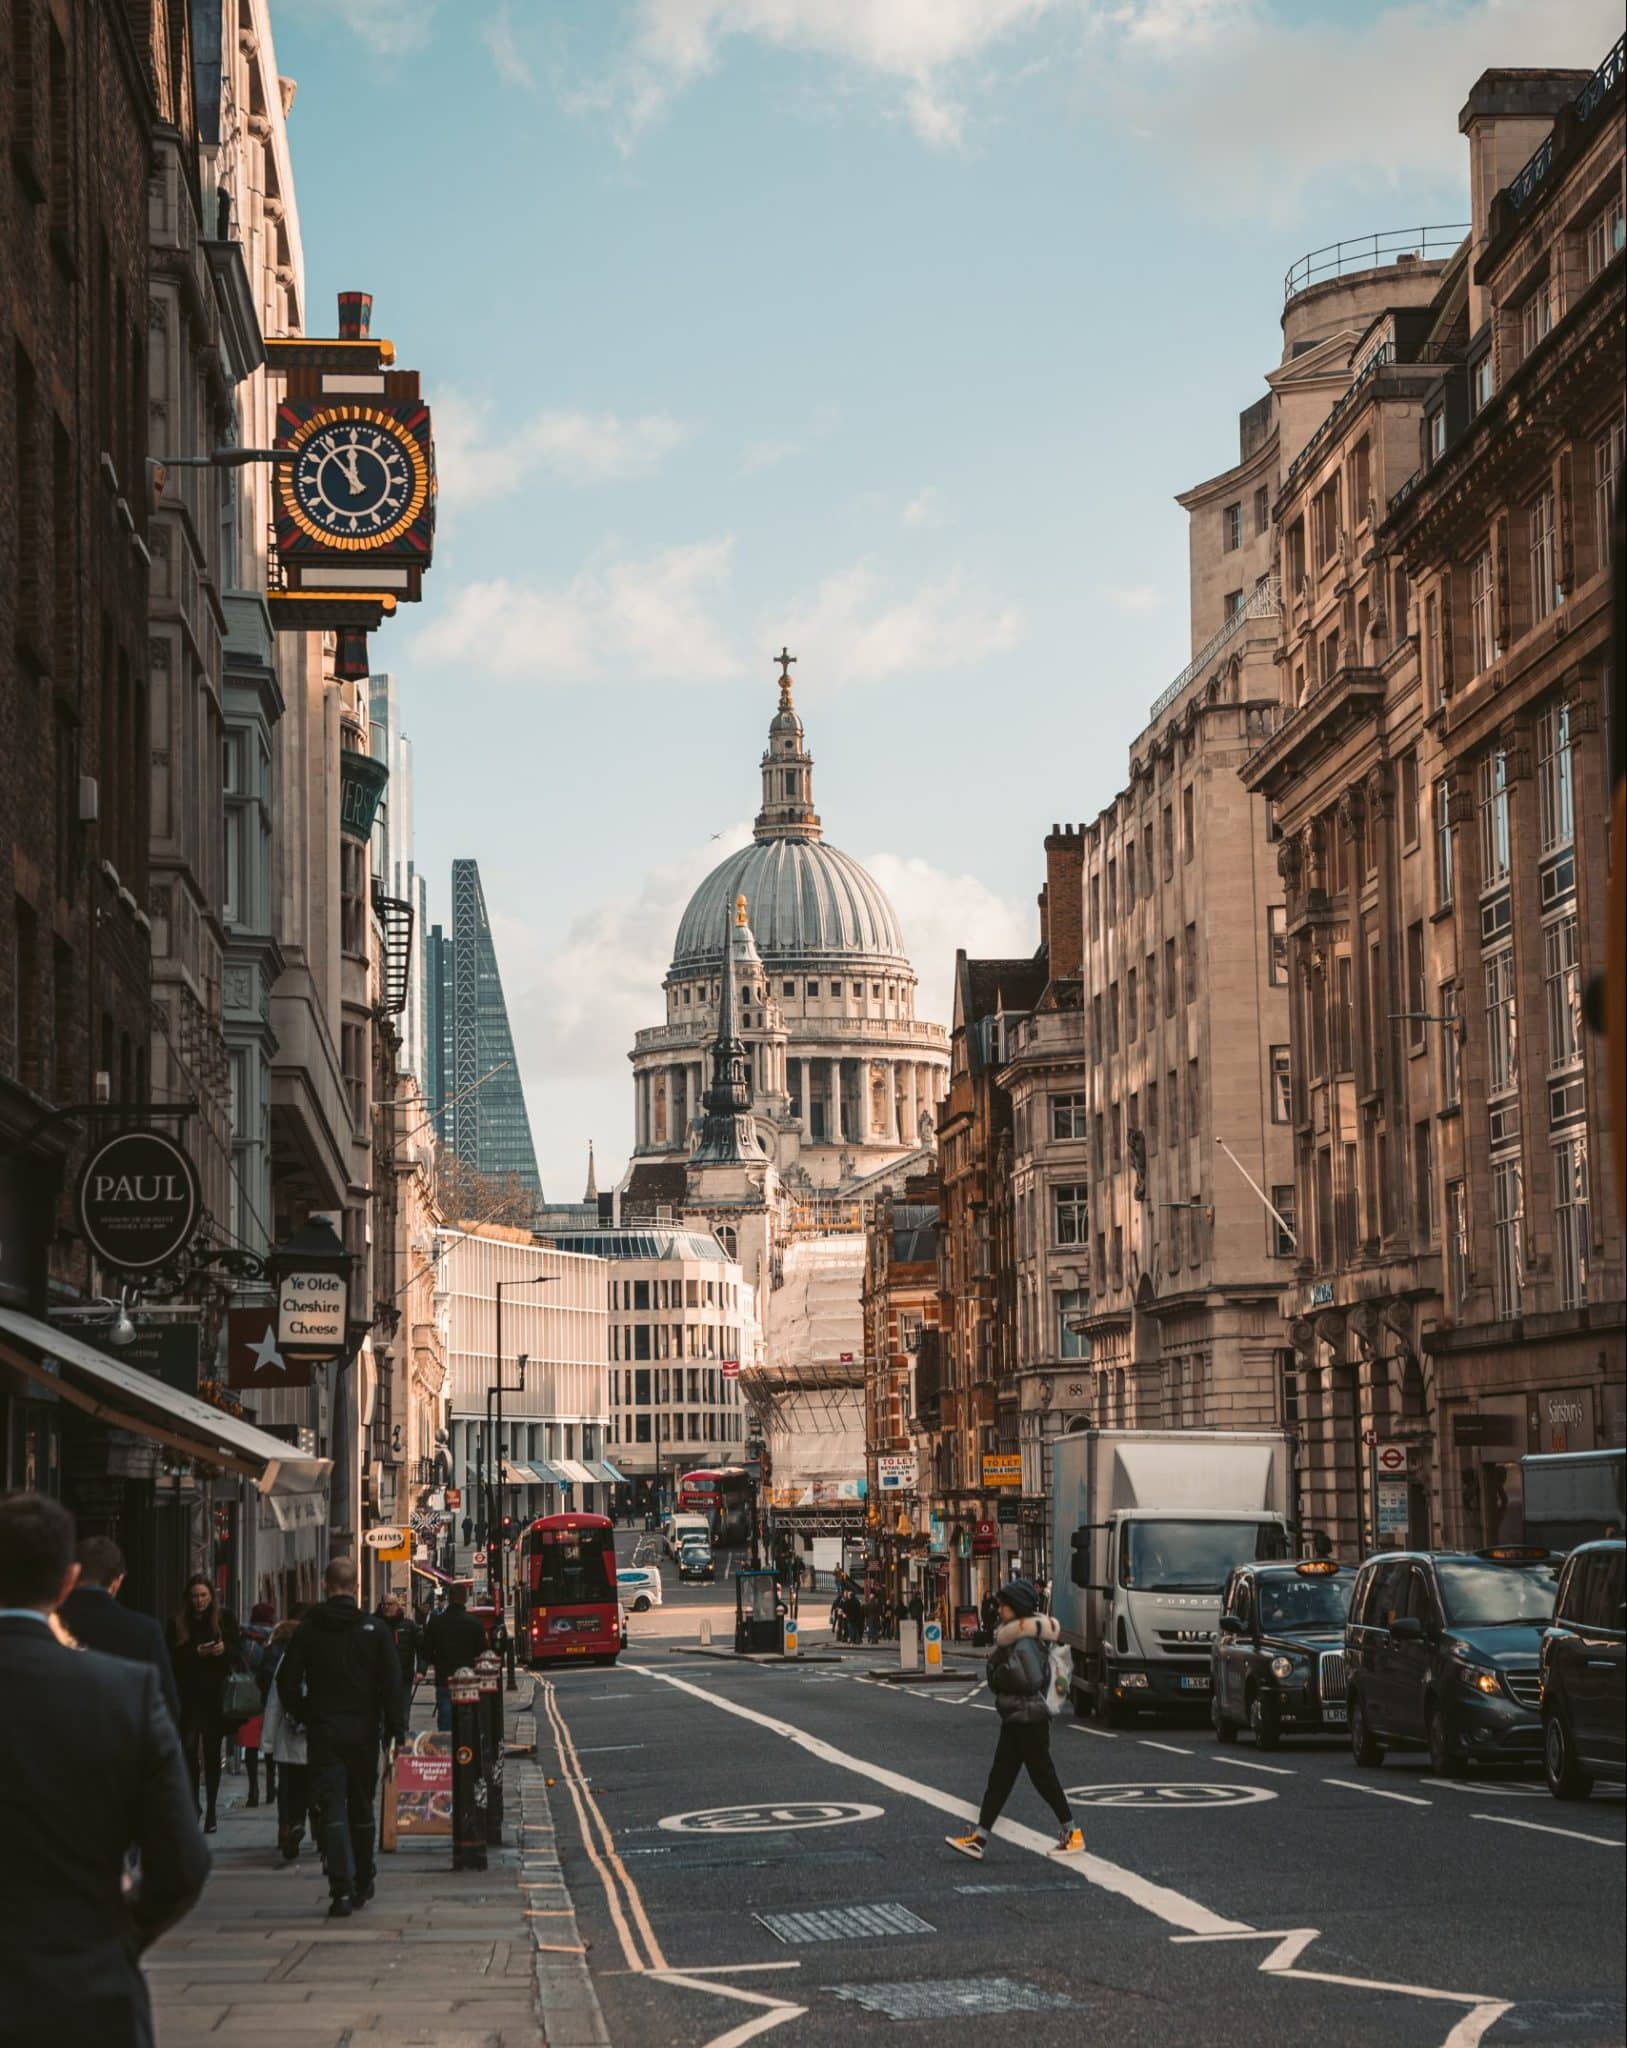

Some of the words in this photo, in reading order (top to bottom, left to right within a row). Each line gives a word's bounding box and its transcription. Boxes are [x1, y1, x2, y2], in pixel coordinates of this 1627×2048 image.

[94, 1175, 185, 1201] PAUL
[291, 1277, 305, 1290] Ye
[307, 1278, 339, 1291] Olde
[283, 1299, 340, 1312] Cheshire
[289, 1321, 338, 1335] Cheese
[1068, 1383, 1083, 1397] 88
[1549, 1399, 1582, 1428] Sainsbury's
[1366, 1431, 1377, 1443] H
[896, 1457, 913, 1465] LET
[1001, 1459, 1018, 1467] LET
[698, 1808, 843, 1828] 20
